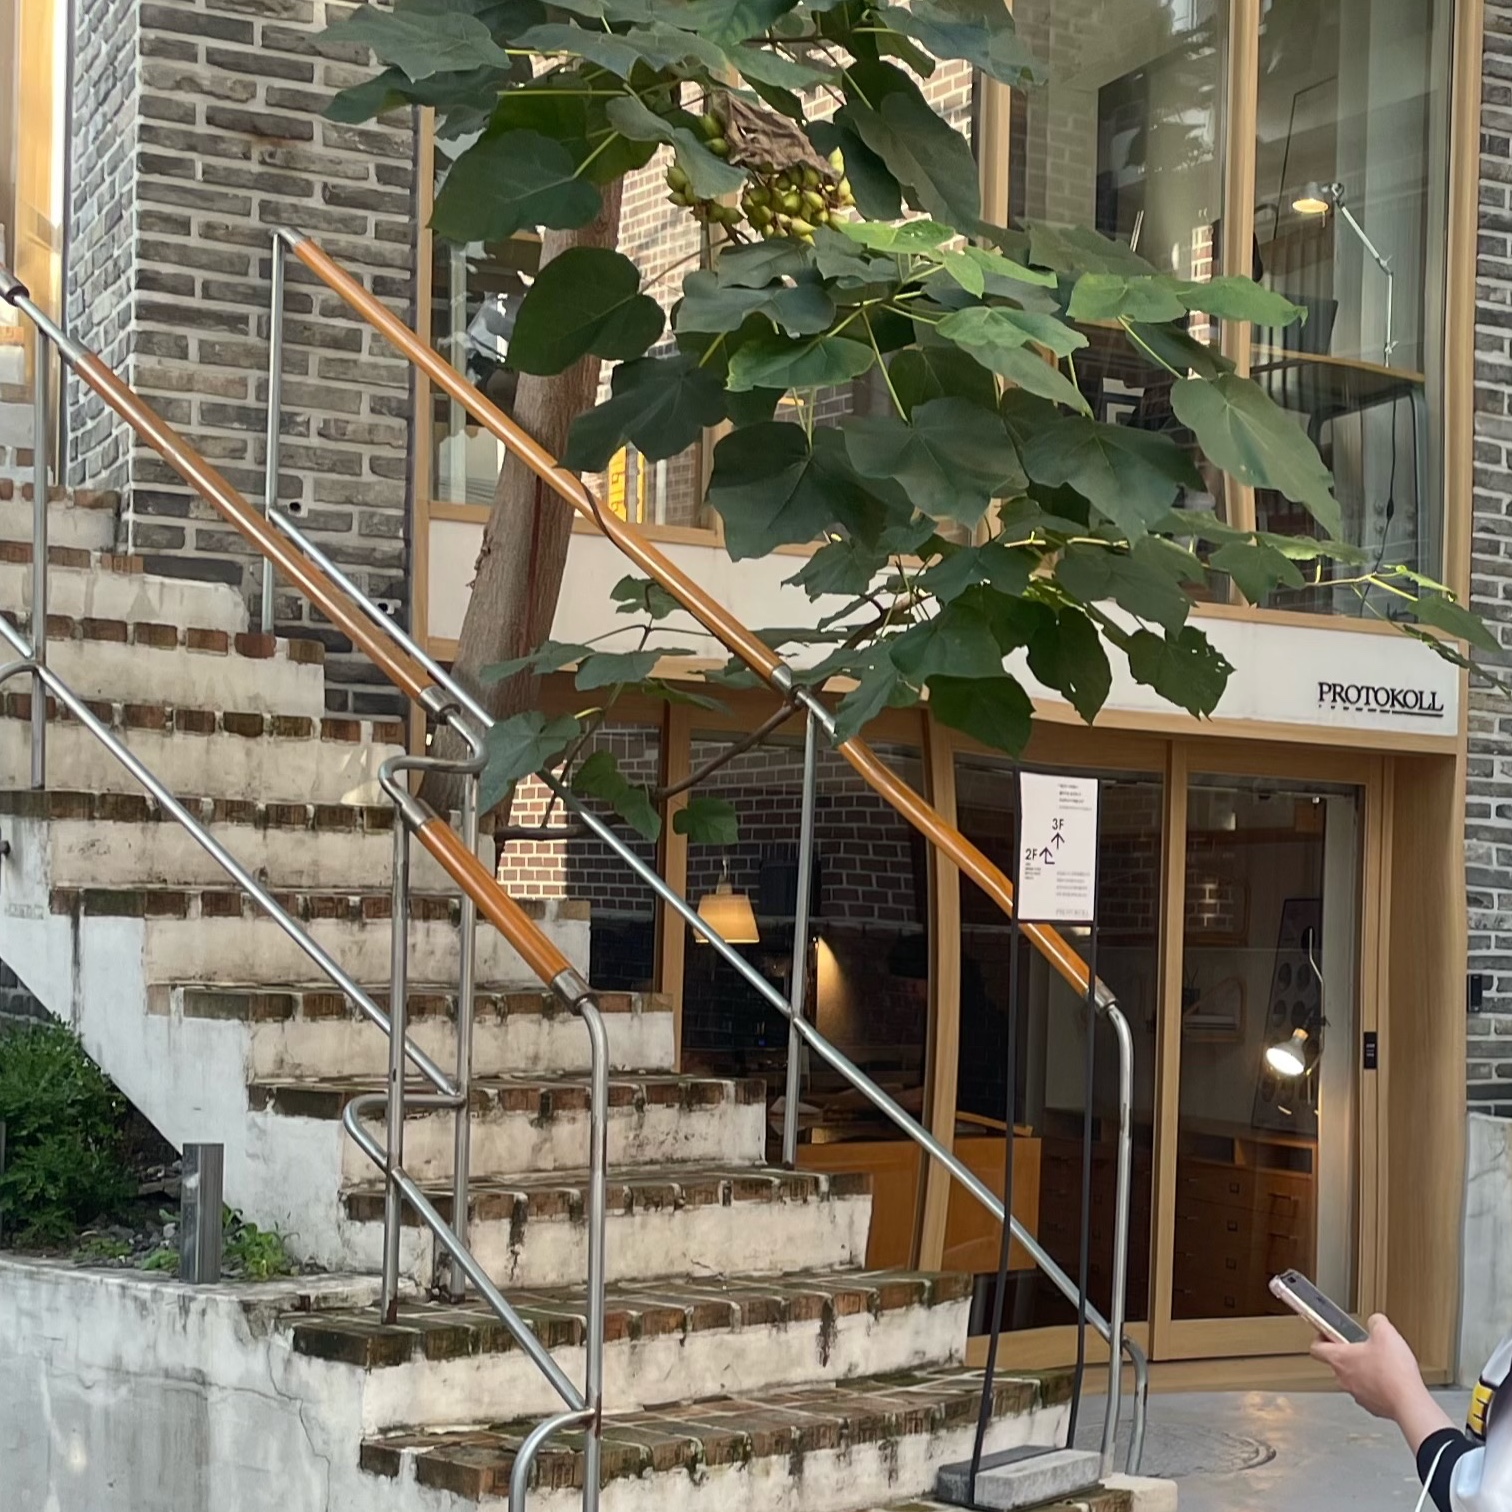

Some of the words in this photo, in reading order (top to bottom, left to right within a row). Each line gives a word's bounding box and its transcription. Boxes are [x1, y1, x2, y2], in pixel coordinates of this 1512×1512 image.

[1318, 682, 1444, 712] PROTOKOLL
[1052, 818, 1064, 831] 3F
[1025, 848, 1038, 861] 2F
